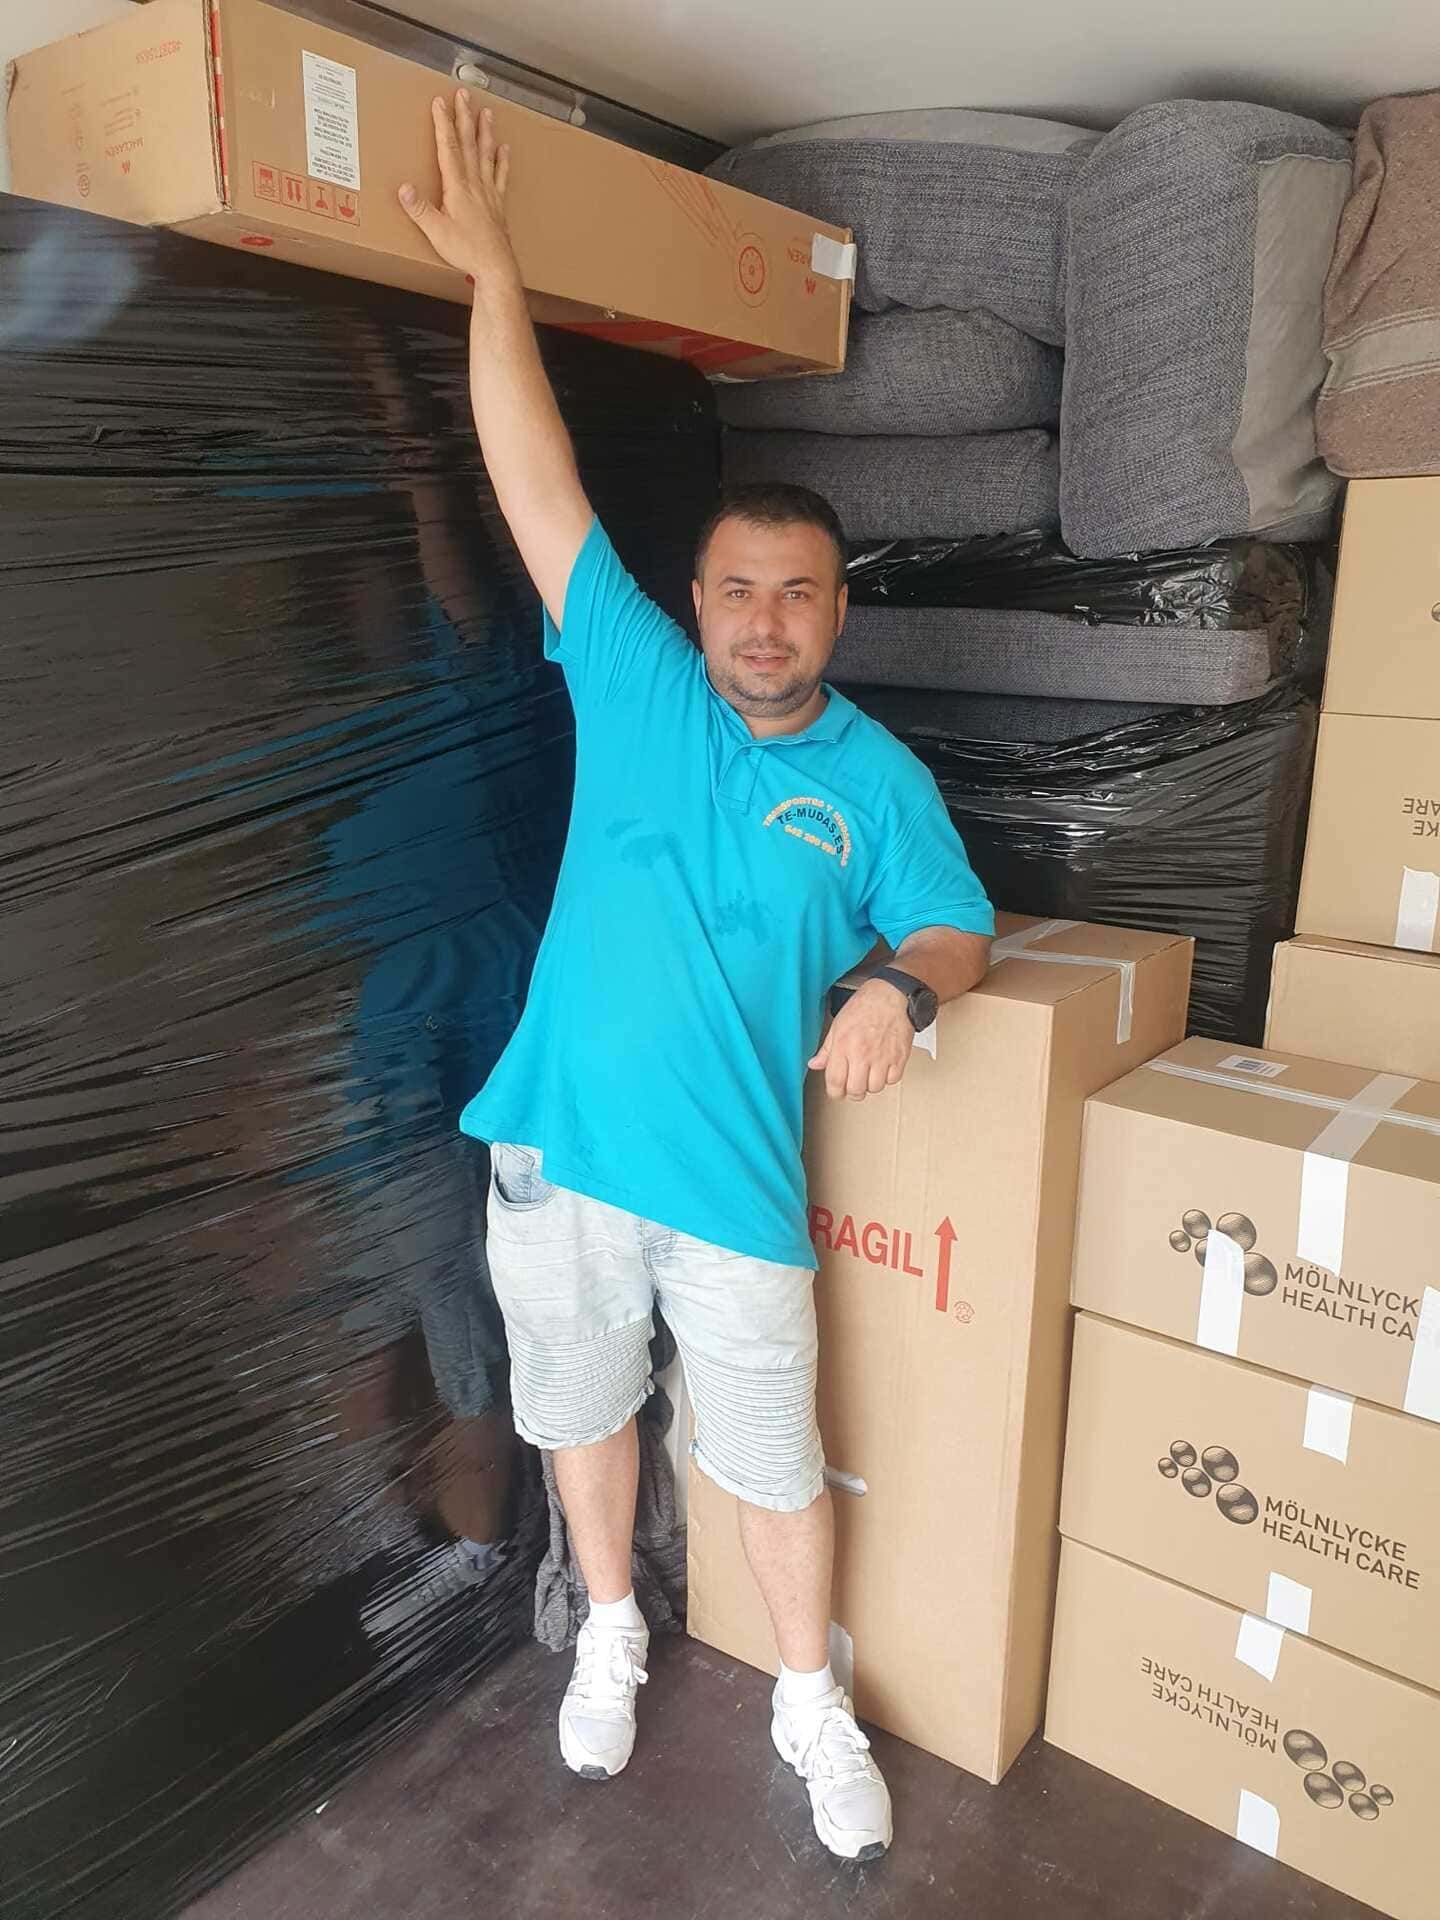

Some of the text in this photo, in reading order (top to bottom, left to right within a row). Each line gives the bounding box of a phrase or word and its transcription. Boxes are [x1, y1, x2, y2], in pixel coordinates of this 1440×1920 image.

[776, 808, 844, 855] TE-MUDAS.ES
[1402, 798, 1440, 816] ARE
[810, 1205, 923, 1278] RAGIL
[1282, 1286, 1415, 1341] HEALTH CA
[1285, 1263, 1419, 1317] MÖLNLYCK
[1262, 1516, 1421, 1590] HEALTH CARE
[1265, 1495, 1408, 1562] MÖLNLYCKE
[1140, 1656, 1279, 1734] HEALTH CARE
[1151, 1681, 1277, 1754] MÖLNLYCKE
